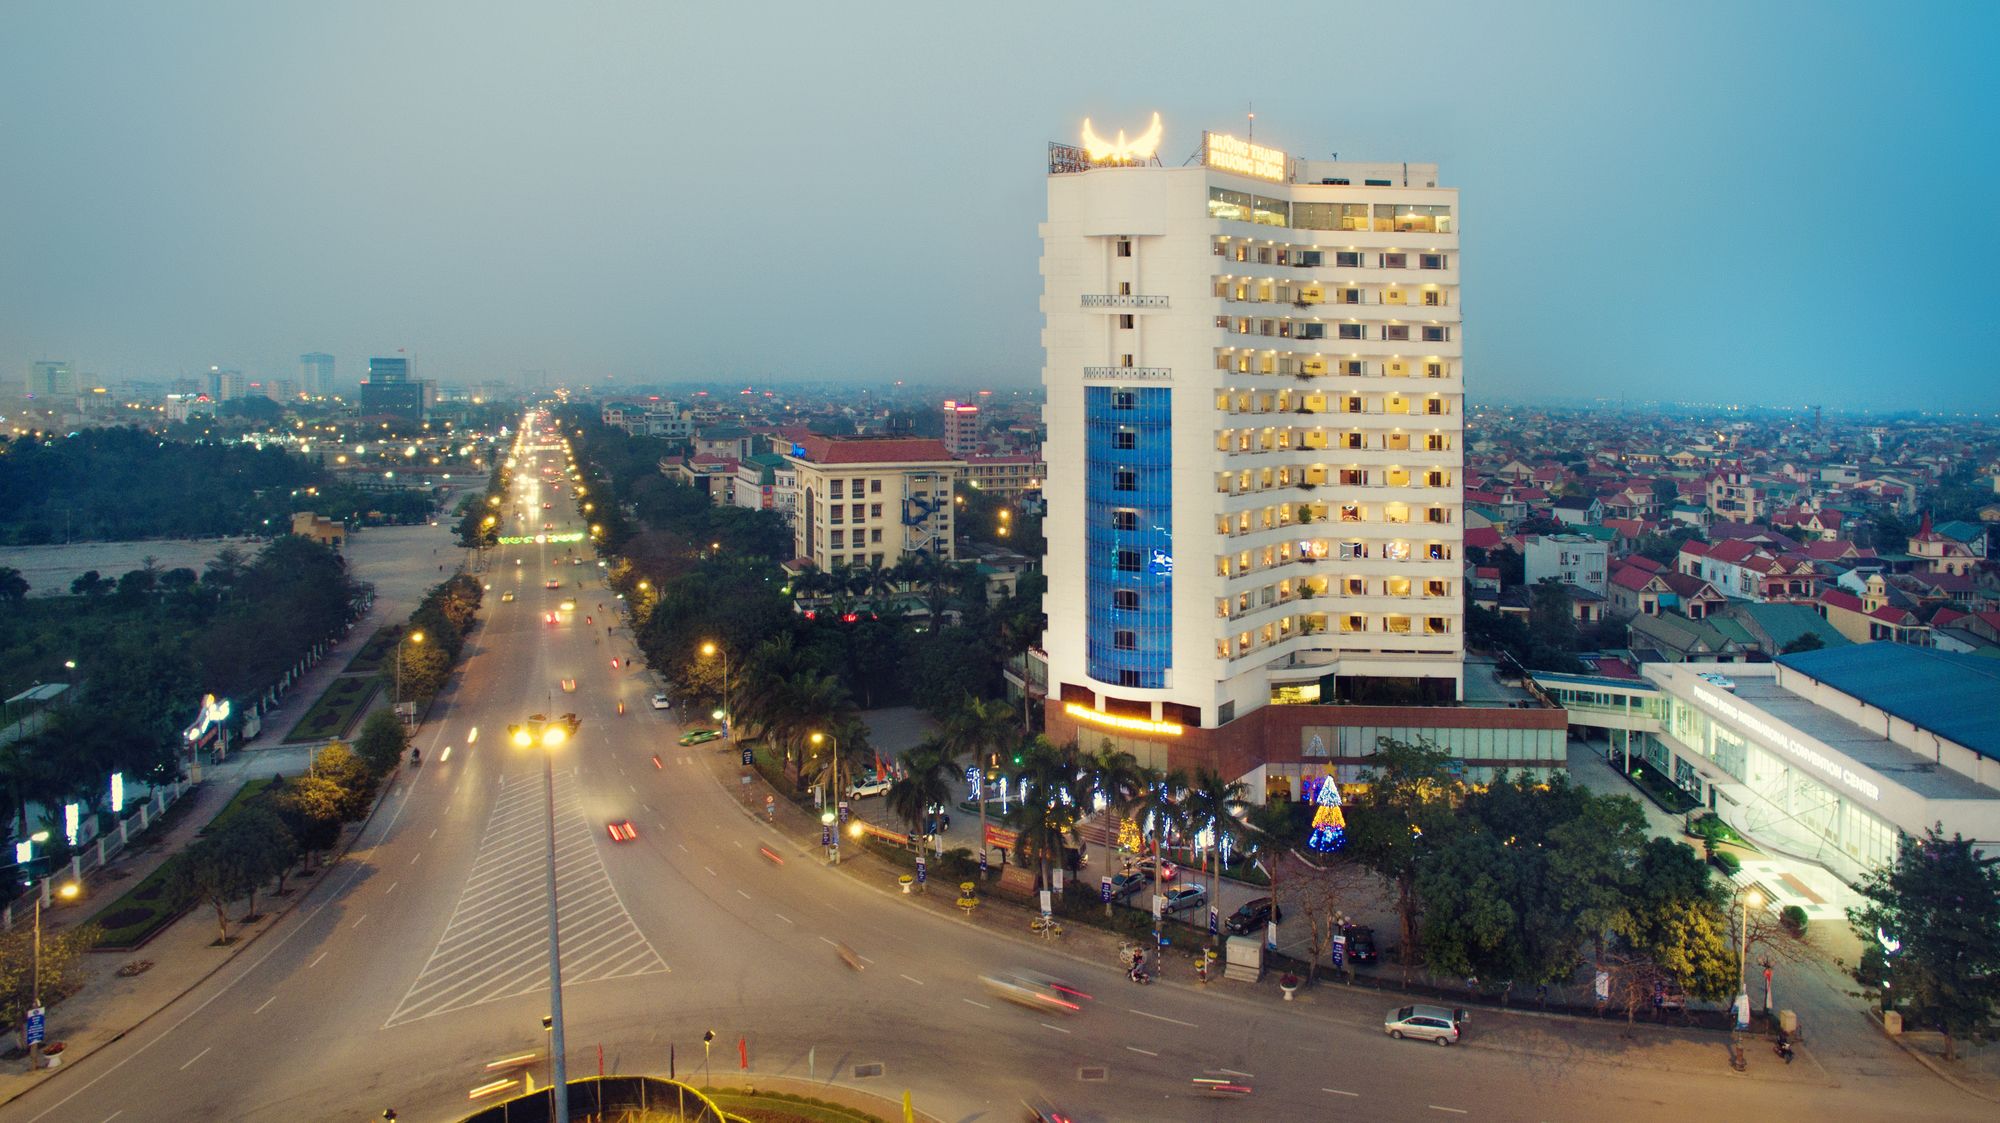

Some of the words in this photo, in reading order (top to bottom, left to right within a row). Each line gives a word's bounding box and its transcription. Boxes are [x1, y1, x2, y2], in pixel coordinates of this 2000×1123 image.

[1250, 144, 1284, 165] THANH
[1255, 160, 1284, 181] ĐÔNG
[1789, 739, 1842, 780] CONVENTION
[1843, 769, 1879, 801] CENTER
